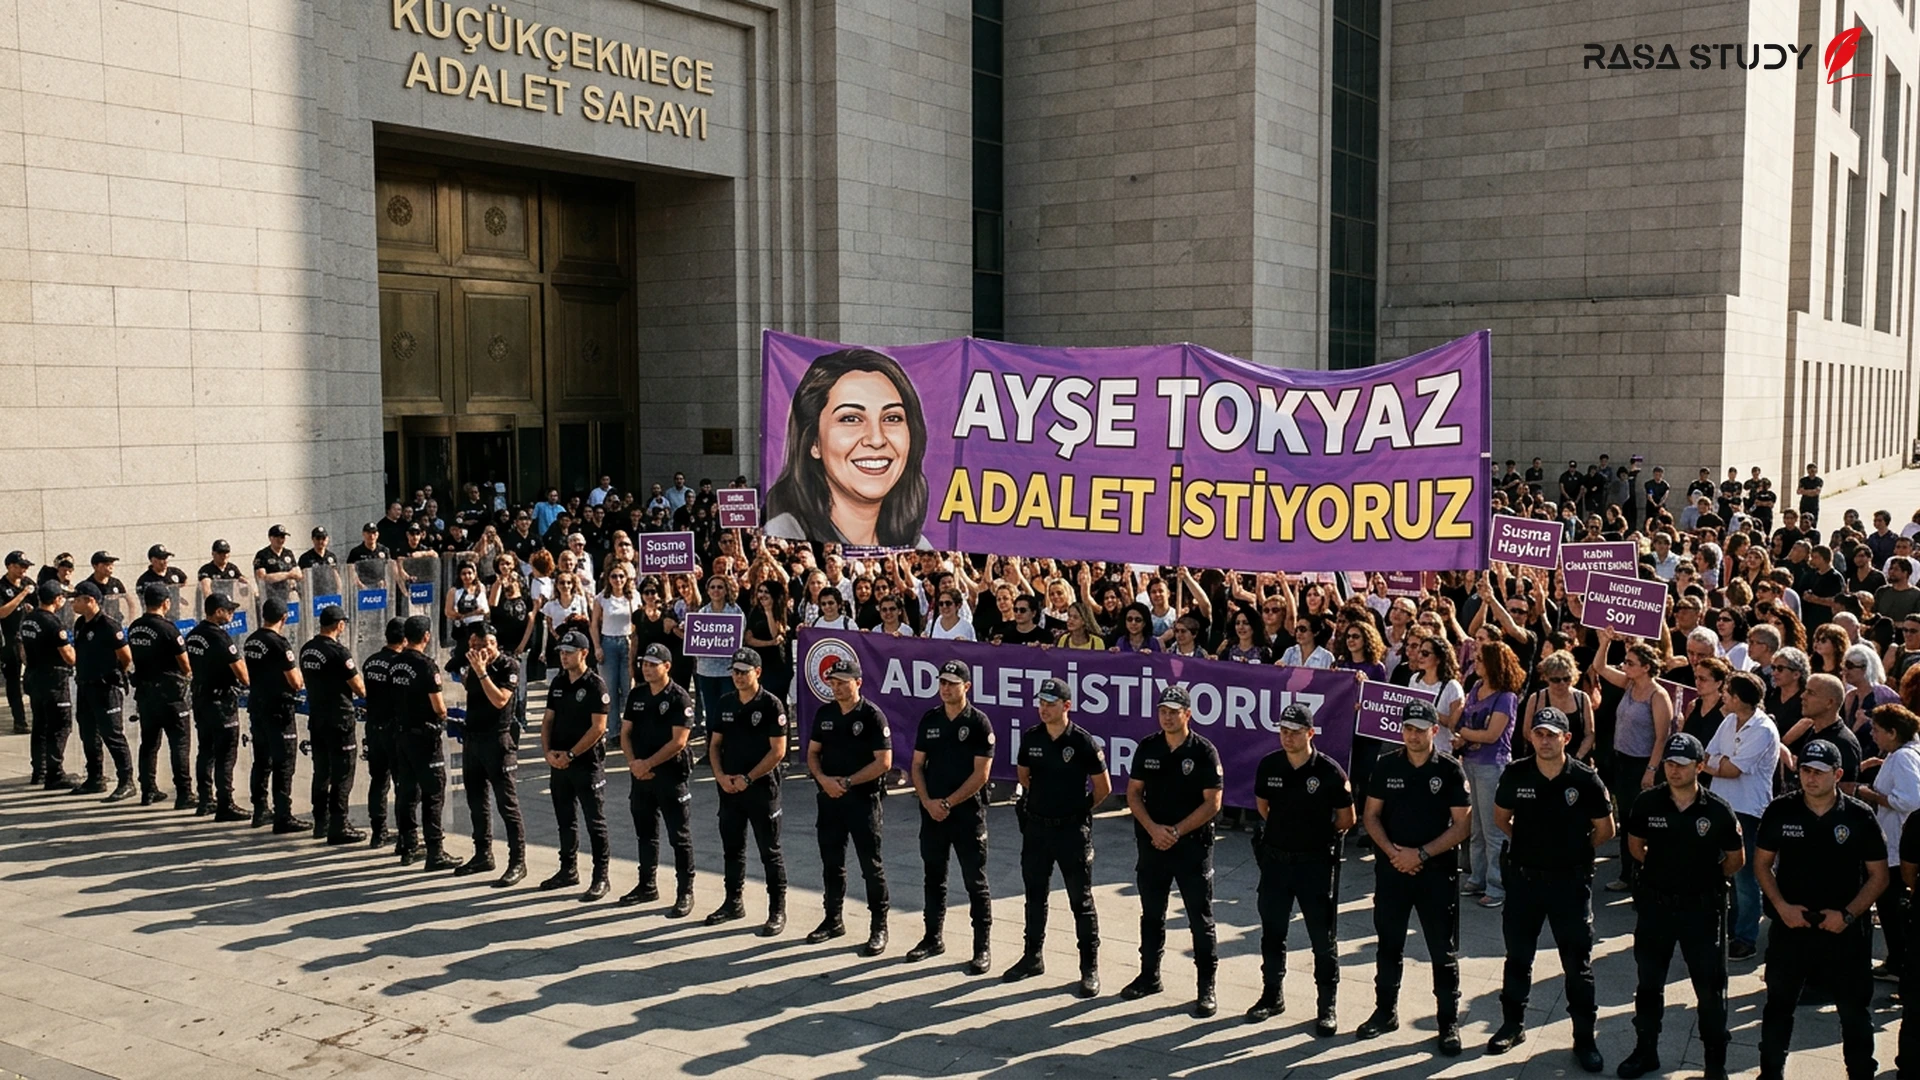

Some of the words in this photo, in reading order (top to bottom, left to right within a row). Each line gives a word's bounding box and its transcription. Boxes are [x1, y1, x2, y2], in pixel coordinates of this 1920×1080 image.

[405, 52, 571, 115] ADALET
[582, 86, 707, 140] SARAYI
[952, 370, 1139, 460] AYŞE
[1156, 370, 1463, 456] TOKYAZ
[938, 467, 1156, 535] ADALET
[1168, 465, 1475, 542] İSTİYORUZ
[1502, 524, 1551, 541] Susma
[880, 658, 1052, 707] ADLET
